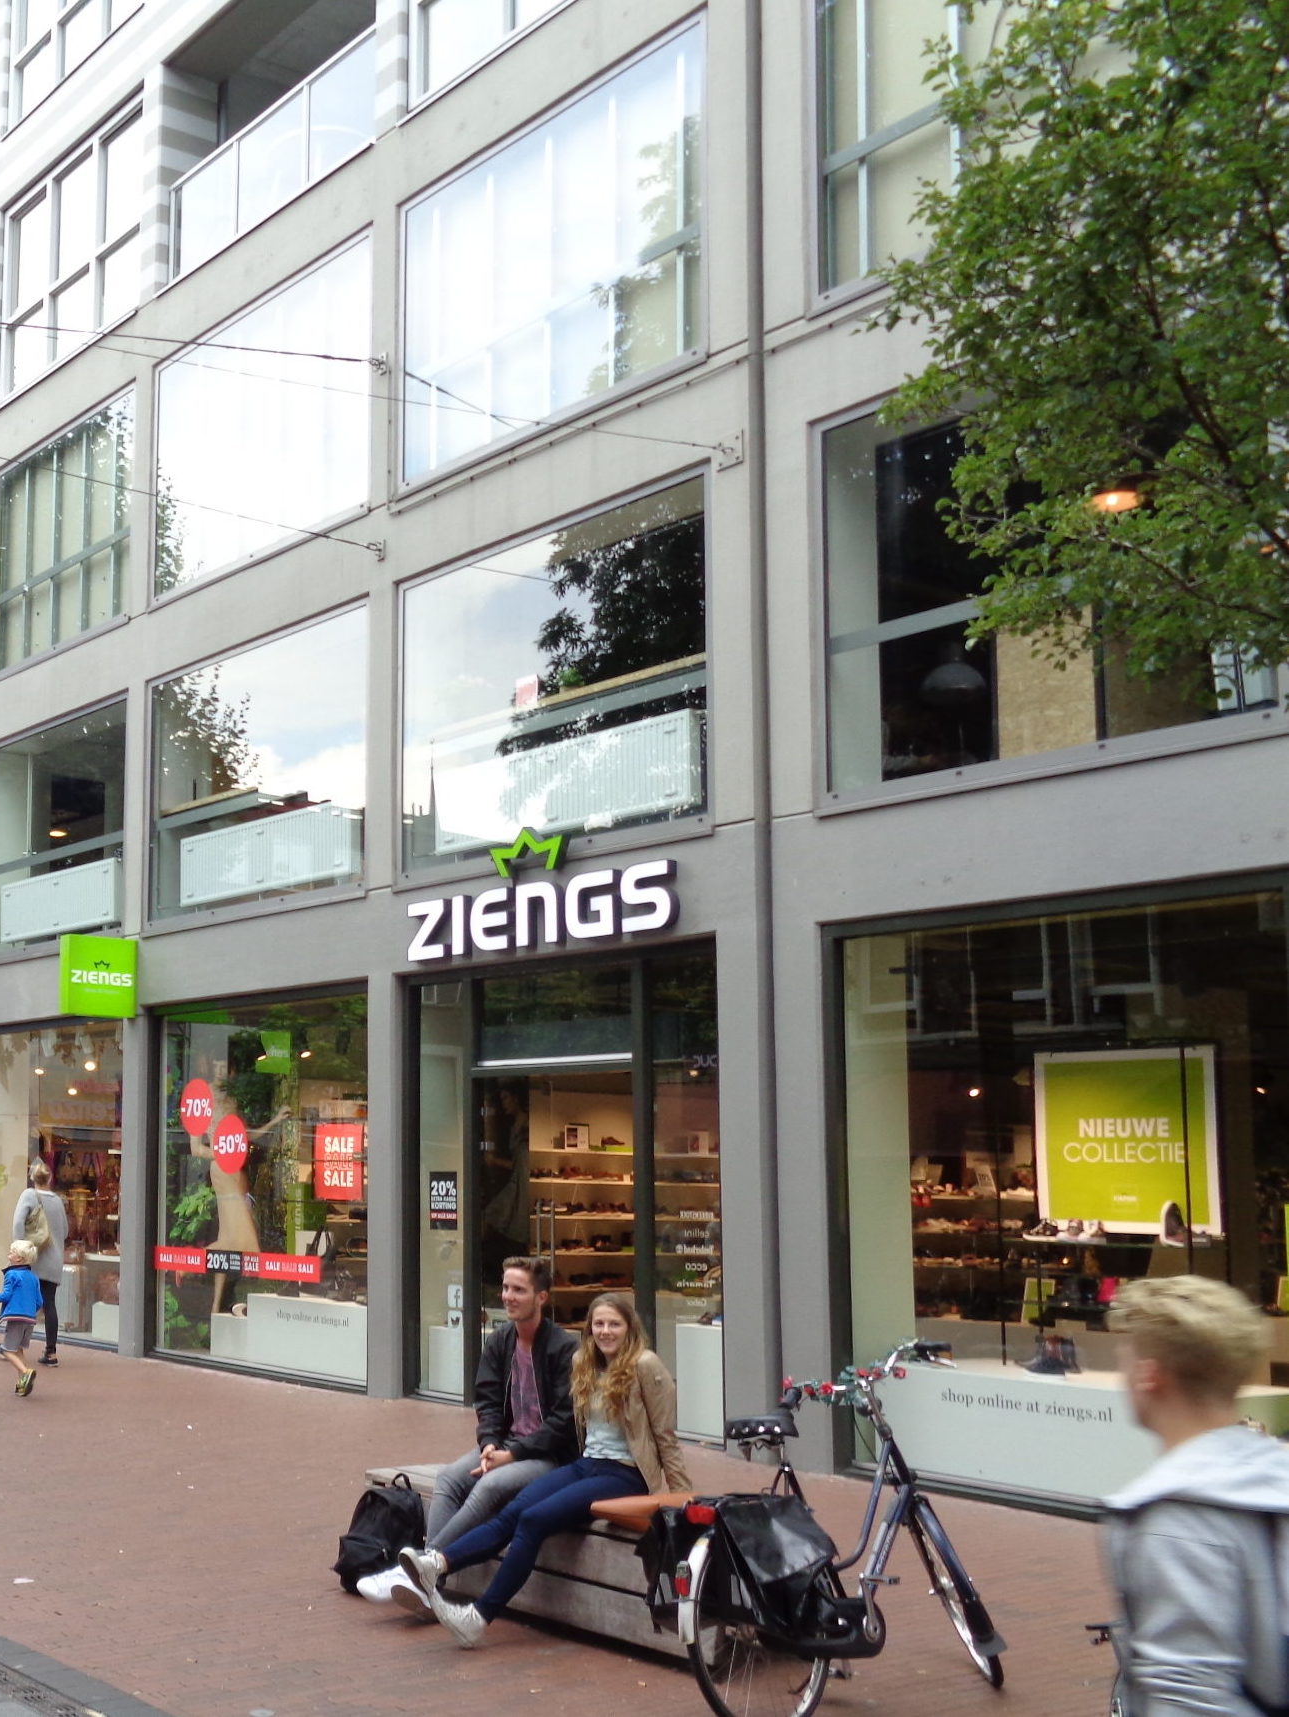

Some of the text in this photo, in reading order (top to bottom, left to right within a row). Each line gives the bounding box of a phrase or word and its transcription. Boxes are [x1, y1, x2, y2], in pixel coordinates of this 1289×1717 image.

[407, 860, 673, 962] ZIENGS
[70, 969, 133, 987] ZIENGS
[181, 1098, 212, 1118] -70%
[1078, 1117, 1170, 1139] NIEUWE
[214, 1133, 247, 1155] -50%
[324, 1135, 355, 1154] SALE
[1063, 1141, 1186, 1164] COLLECTIE
[324, 1153, 354, 1171] SALE
[323, 1170, 354, 1188] SALE
[430, 1180, 457, 1196] 20%
[430, 1202, 457, 1210] KORTING
[159, 1253, 173, 1263] SALE
[187, 1255, 201, 1265] SALE
[206, 1252, 229, 1270] 20%
[244, 1262, 260, 1272] SALE
[265, 1261, 281, 1272] SALE
[297, 1263, 315, 1274] SALE
[940, 1387, 1113, 1423] shop online at ziengs.nl
